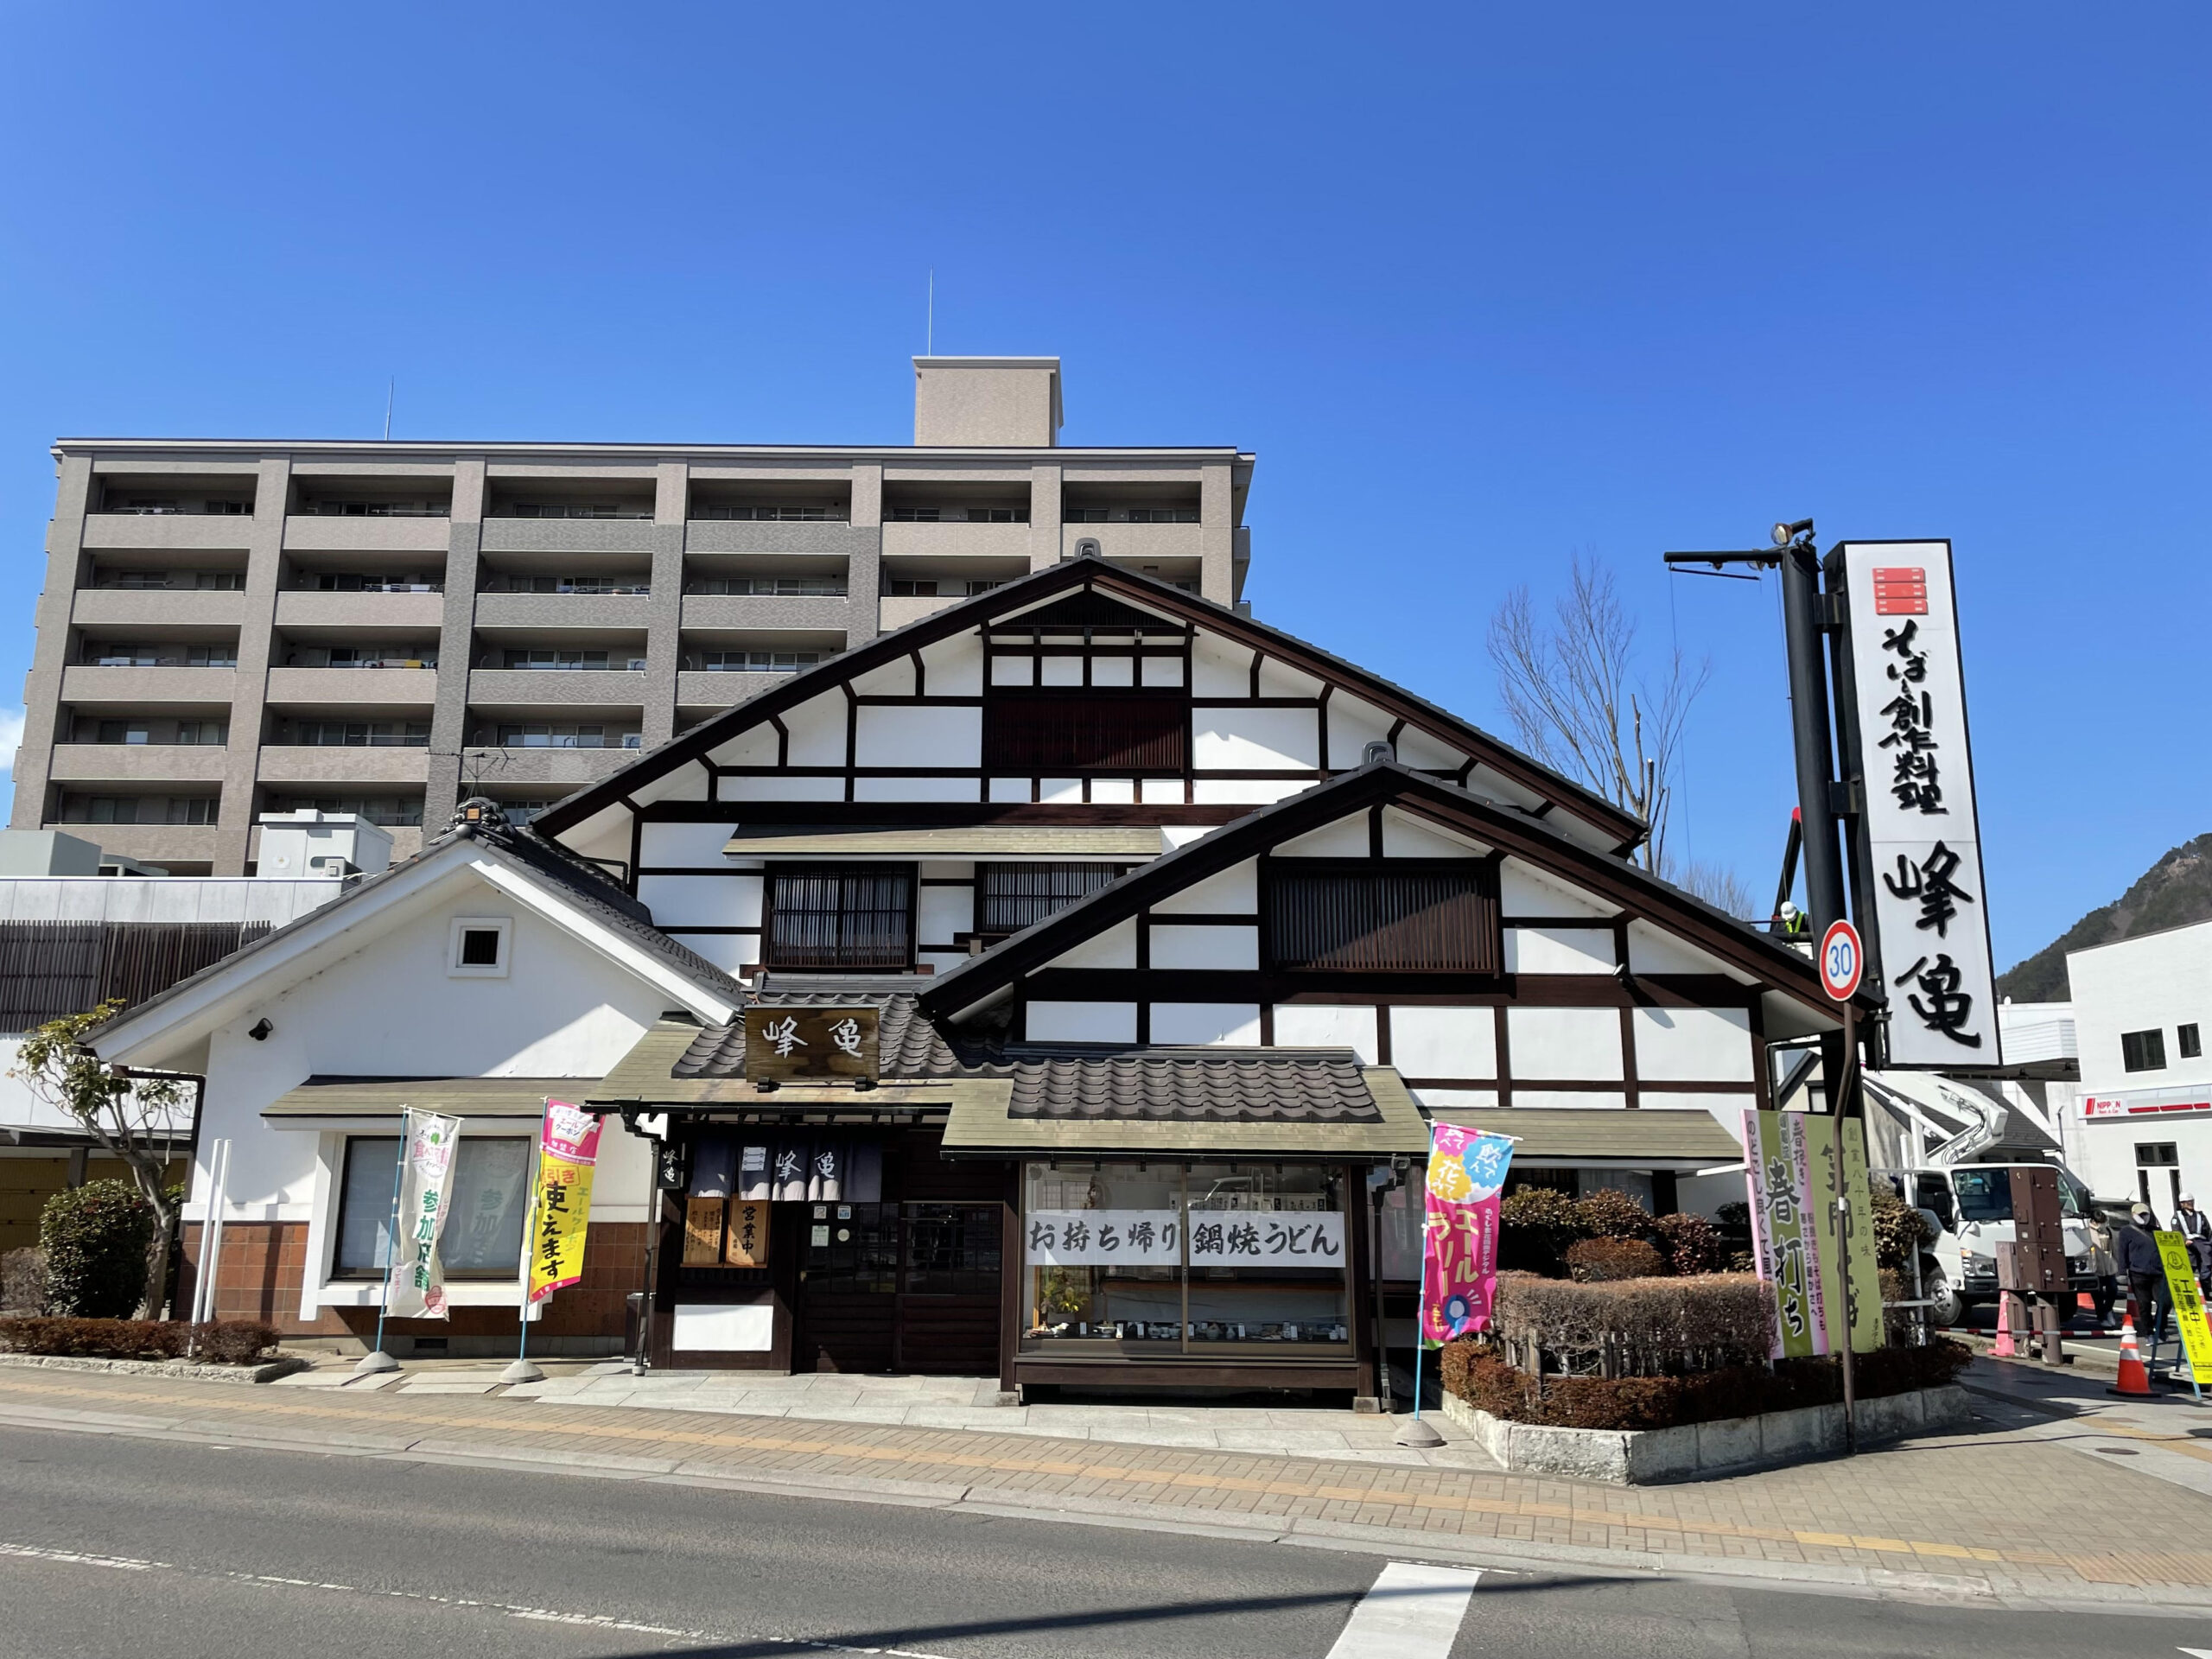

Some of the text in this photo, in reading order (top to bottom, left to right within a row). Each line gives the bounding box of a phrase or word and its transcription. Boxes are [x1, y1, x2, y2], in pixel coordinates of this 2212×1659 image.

[1829, 943, 1852, 977] 30
[1884, 840, 1982, 1048] 峰亀
[762, 1016, 863, 1058] 峰亀
[663, 1150, 678, 1183] 峰亀
[776, 1150, 836, 1181] 峰亀
[538, 1180, 569, 1280] 使えます
[741, 1205, 757, 1255] 営業中
[1029, 1221, 1339, 1256] お持ち帰り 鍋焼うどん
[1455, 1210, 1479, 1283] エール
[1766, 1157, 1802, 1336] 春打ち
